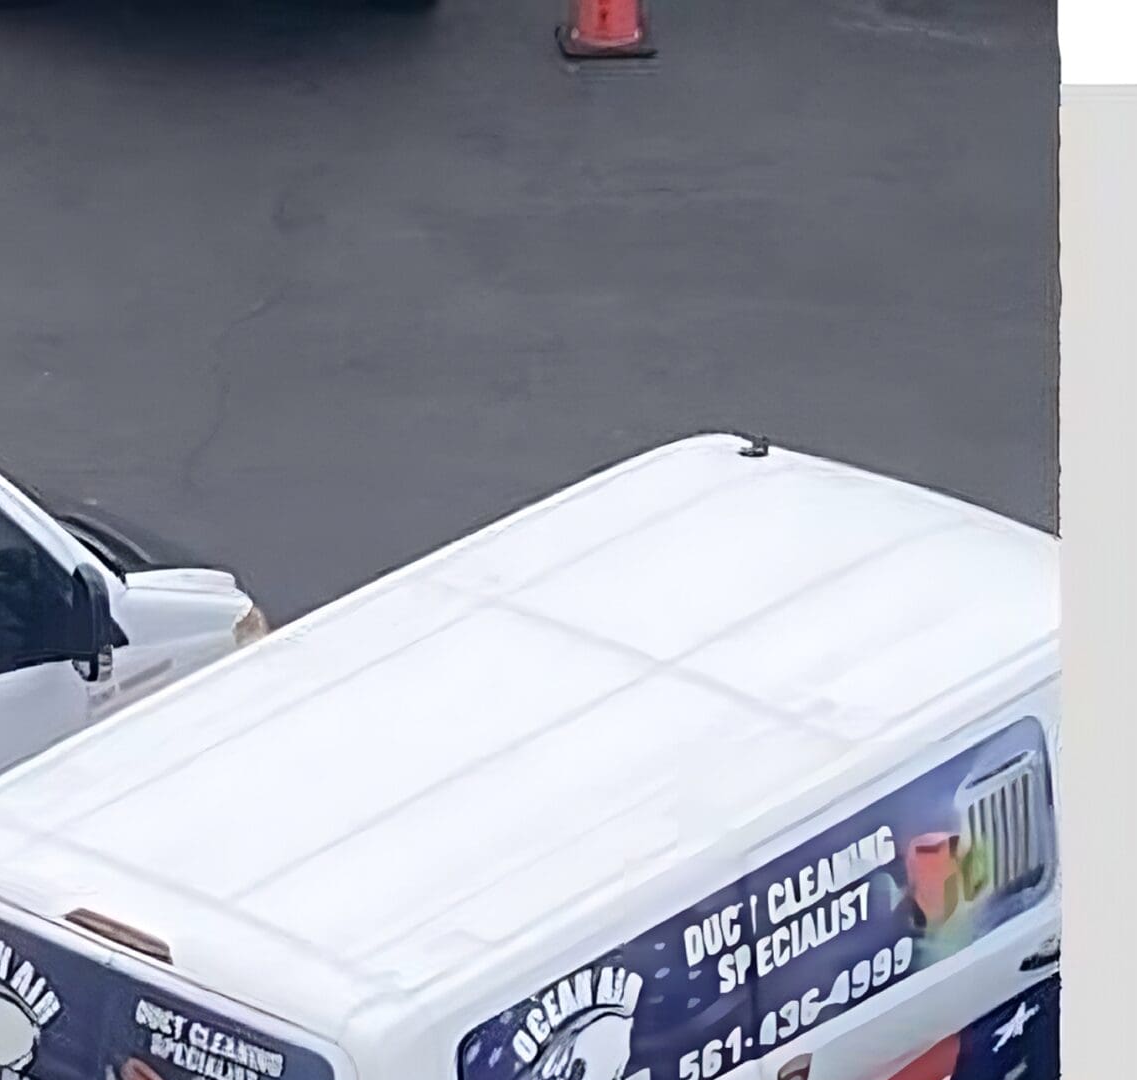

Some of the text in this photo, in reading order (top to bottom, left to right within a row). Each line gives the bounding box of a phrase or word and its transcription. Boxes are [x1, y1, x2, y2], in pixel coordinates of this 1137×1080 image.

[717, 882, 870, 994] SPECIALIST
[10, 960, 61, 1025] AIR
[513, 968, 593, 1064] OCEAN
